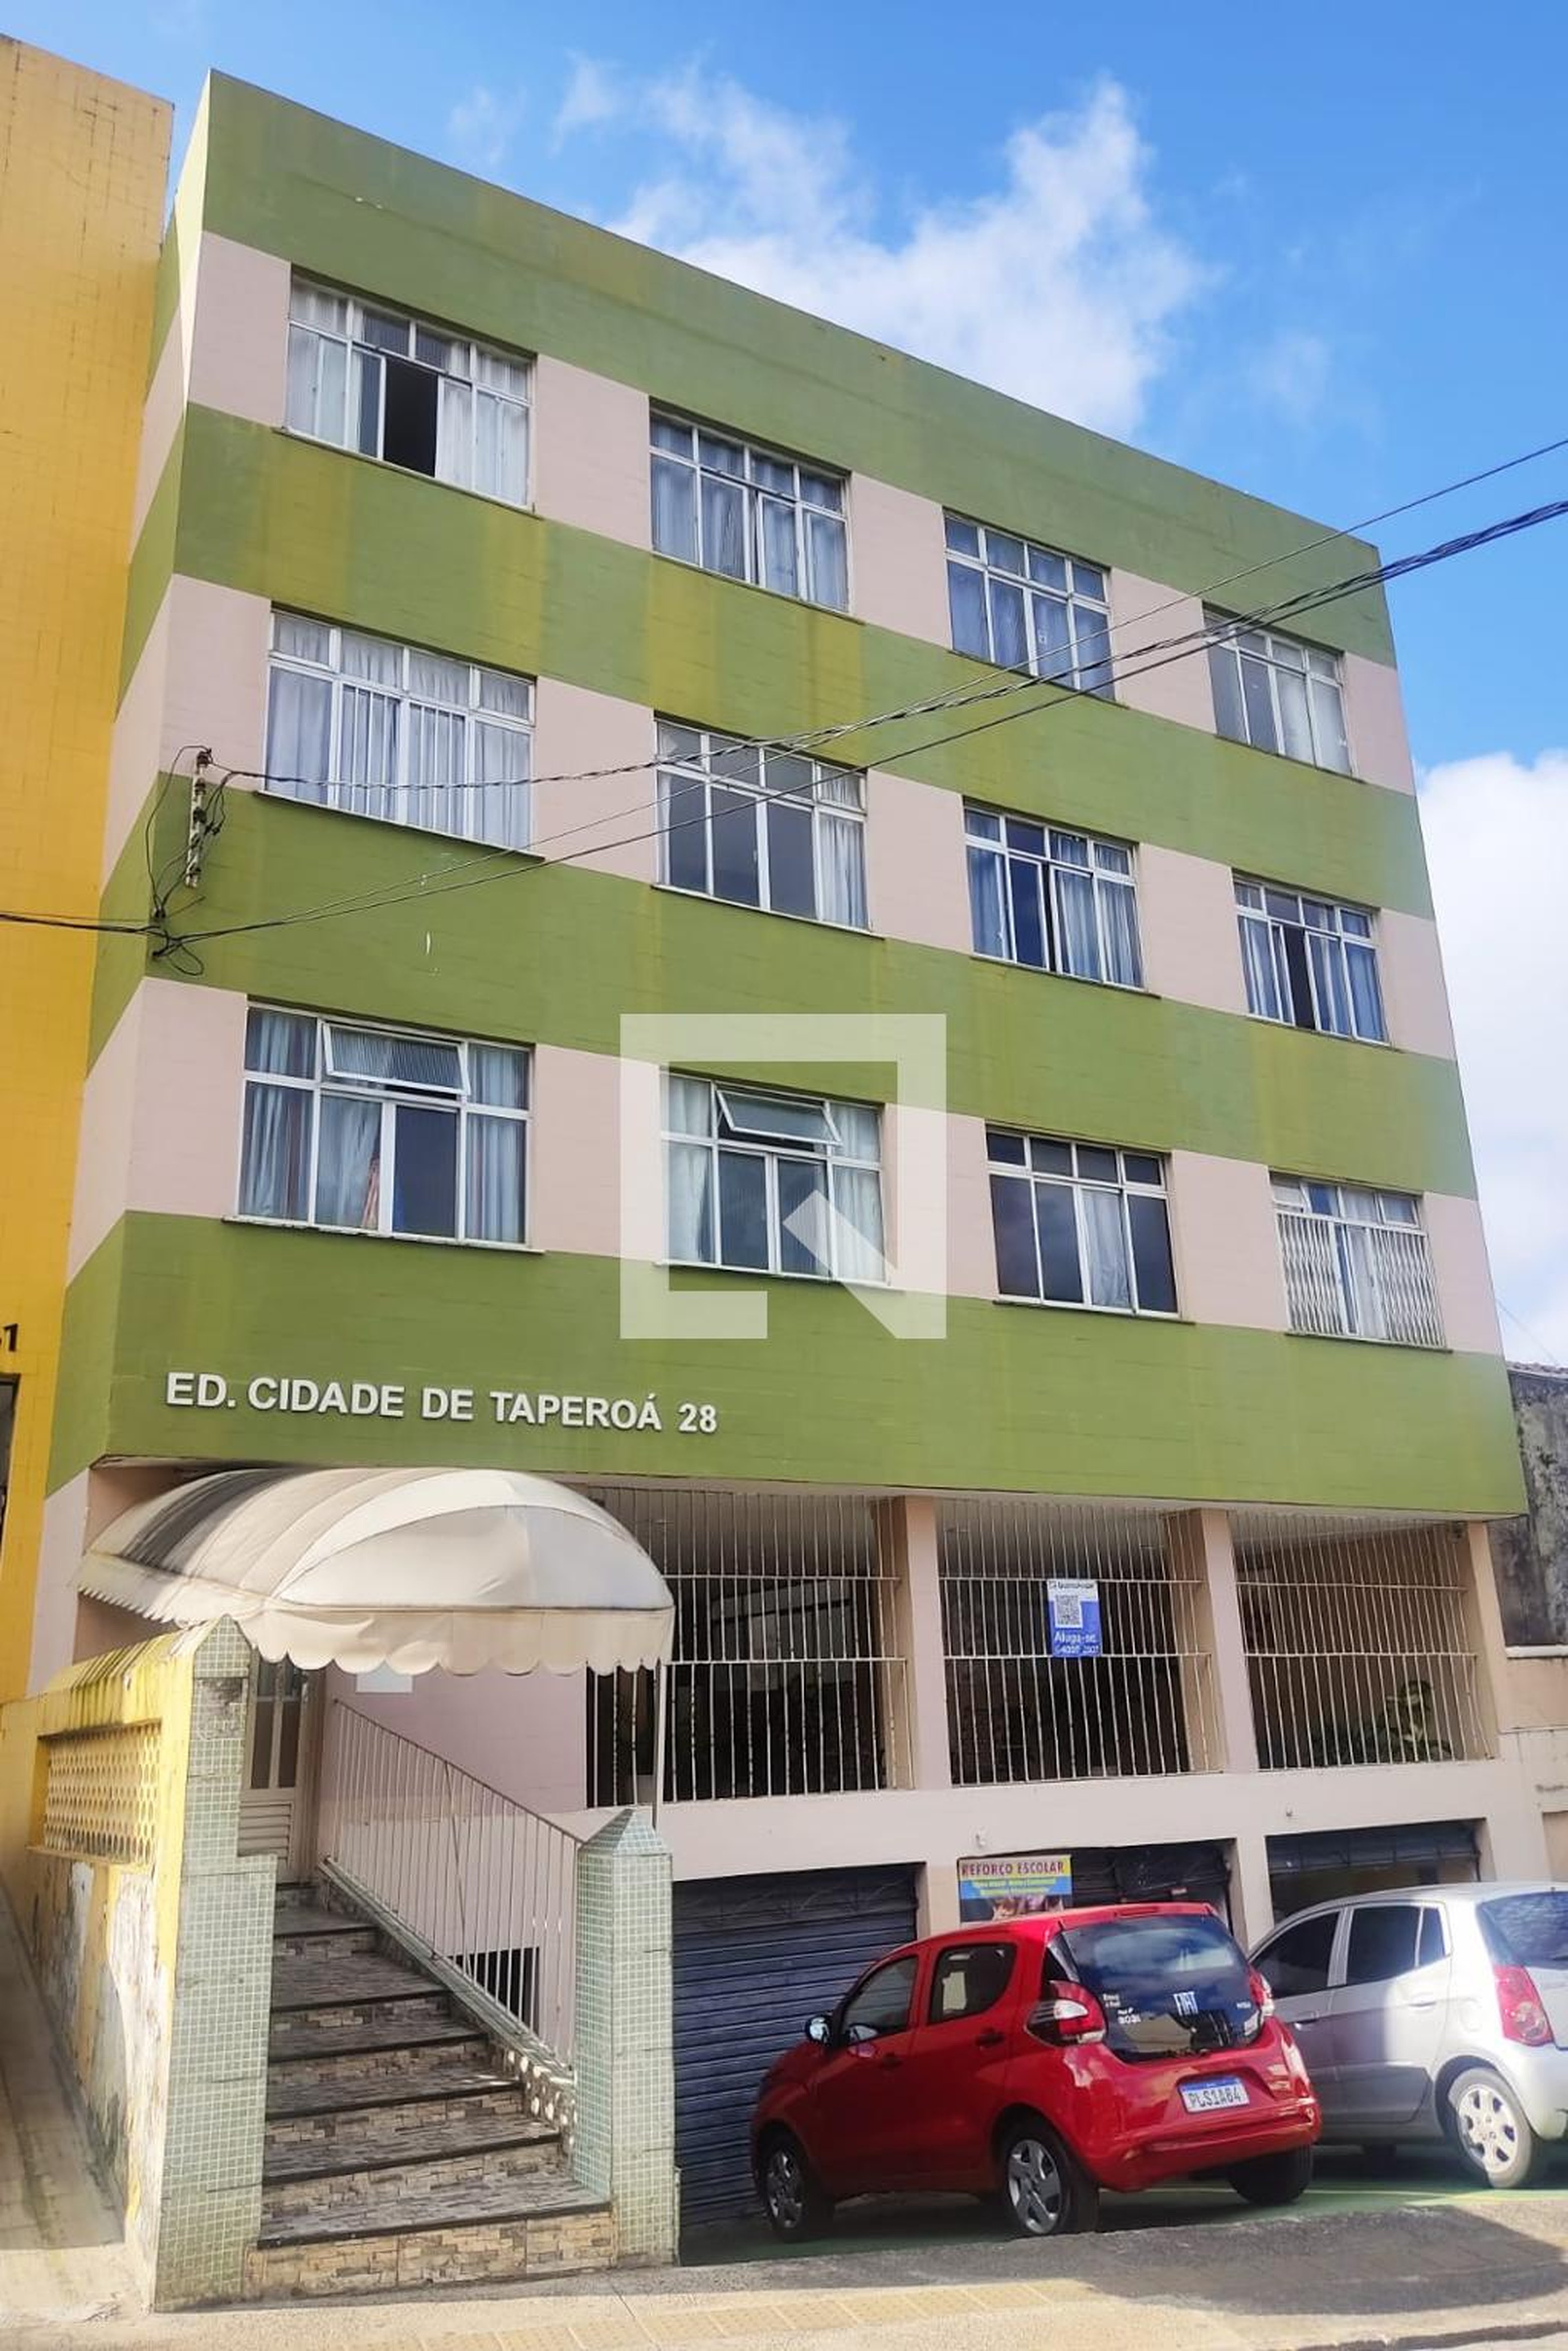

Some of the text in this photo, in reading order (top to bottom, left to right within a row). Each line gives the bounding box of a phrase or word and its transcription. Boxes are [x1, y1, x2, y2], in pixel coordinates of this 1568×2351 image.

[167, 1372, 717, 1432] ED. CIDADE DE TAPEROÁ 28
[962, 1862, 1064, 1876] REFORÇO ESCOLAR
